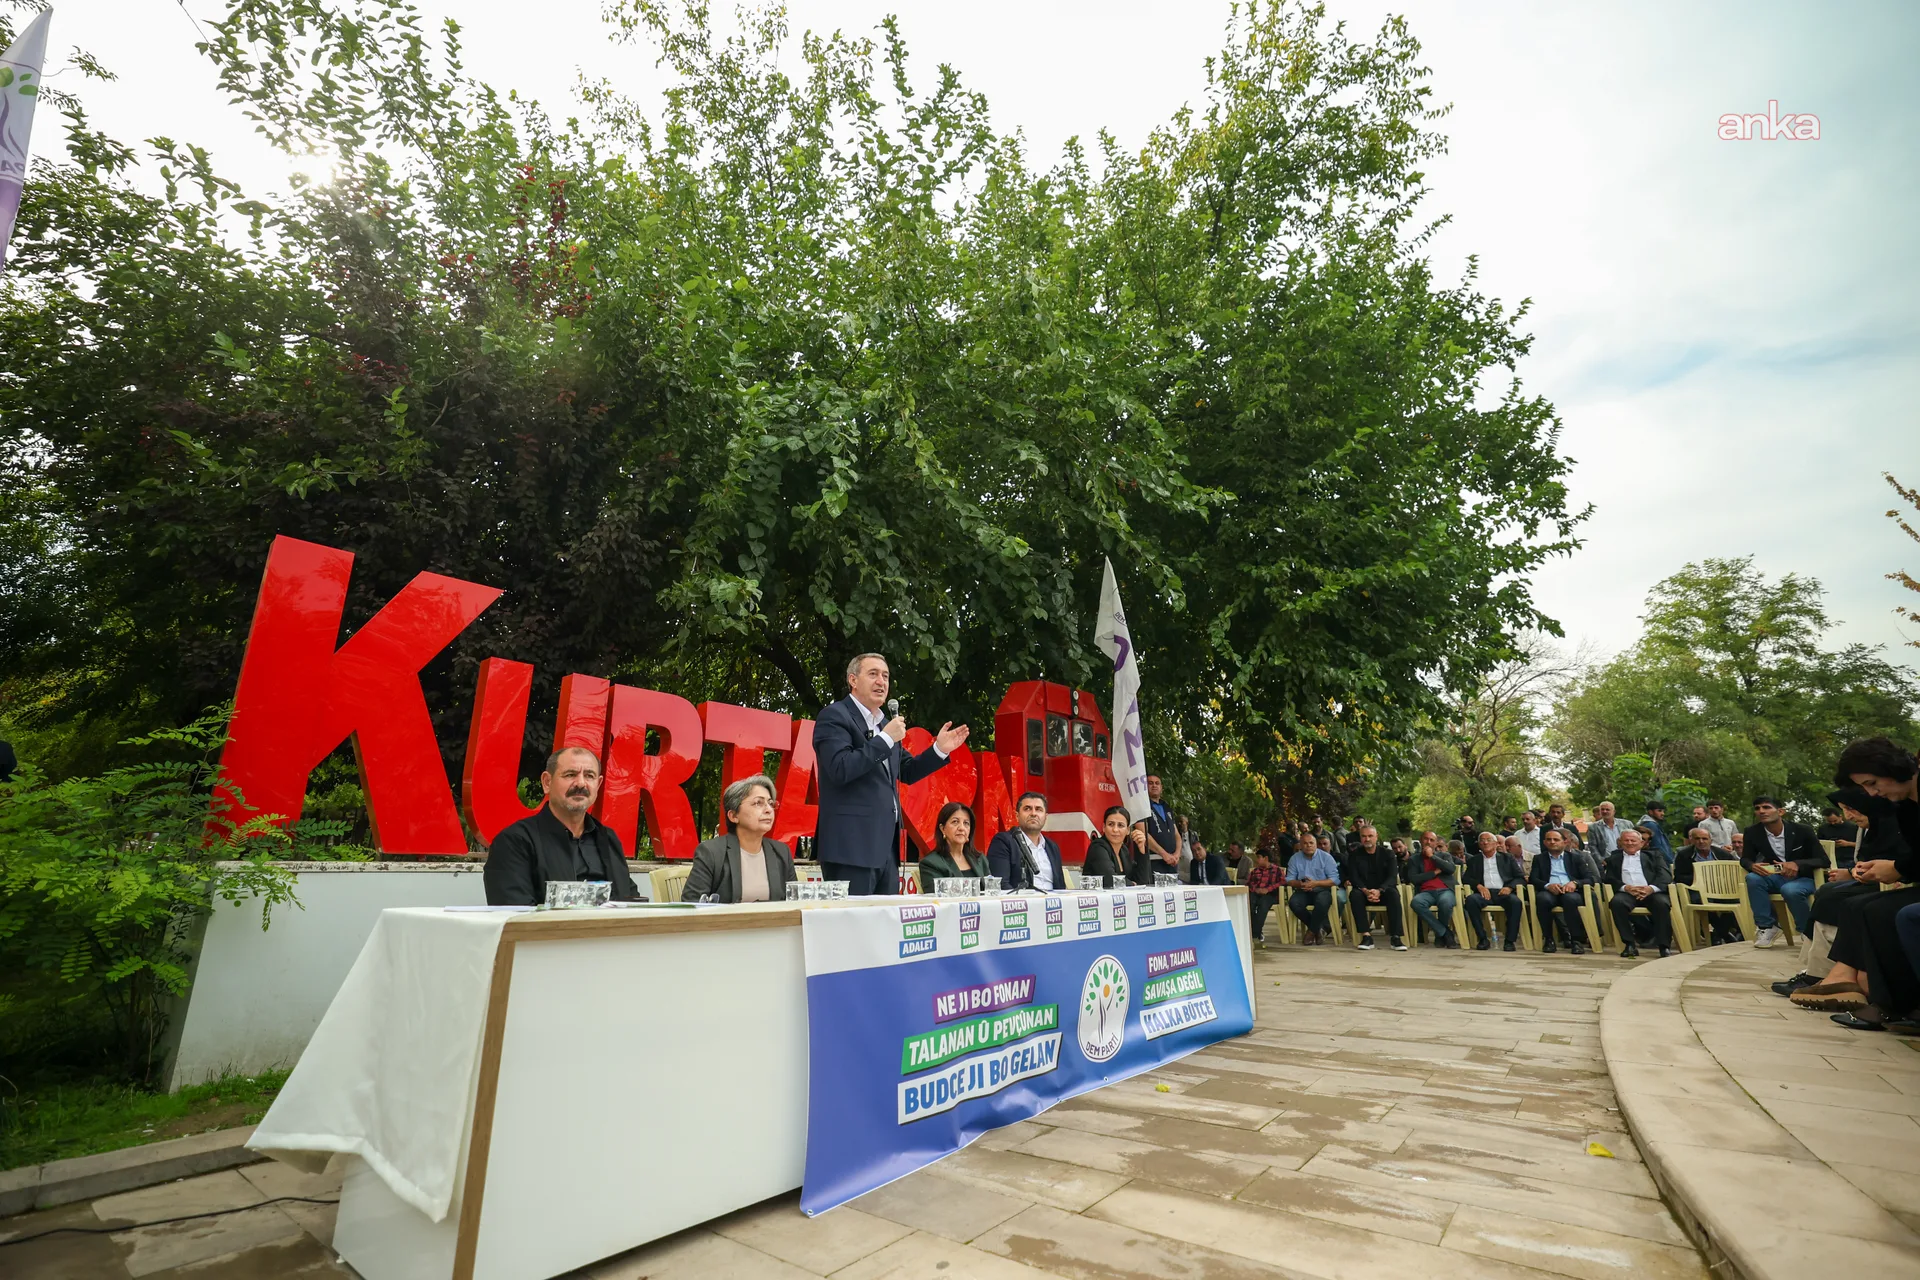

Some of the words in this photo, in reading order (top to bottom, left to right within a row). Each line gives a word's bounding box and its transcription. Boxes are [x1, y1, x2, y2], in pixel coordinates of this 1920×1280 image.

[901, 906, 934, 920] EKMEK
[961, 903, 978, 914] NAN
[1003, 901, 1027, 912] EKMEK
[962, 916, 978, 930] AŞTİ
[1005, 914, 1025, 926] BARIŞ
[905, 922, 931, 936] BARIŞ
[1048, 925, 1061, 937] DAD
[1079, 922, 1100, 933] ADALET
[962, 934, 977, 946] DAD
[1001, 929, 1029, 942] ADALET
[902, 939, 934, 955] ADALET
[1148, 954, 1170, 973] FONA,
[1170, 949, 1195, 967] TALANA
[1144, 978, 1177, 1001] SAVAŞA
[1176, 970, 1203, 993] DEĞİL
[936, 993, 957, 1018] NE
[959, 990, 969, 1013] JI
[971, 987, 992, 1009] BO
[993, 979, 1031, 1006] FONAN
[1143, 1007, 1184, 1034] HALKA
[1181, 1000, 1213, 1021] BÜTÇE
[909, 1024, 975, 1066] TALANAN
[978, 1020, 990, 1043] Û
[993, 1008, 1053, 1041] PEVÇÛNAN
[1085, 1041, 1100, 1056] DEM
[1101, 1032, 1119, 1056] PARTİ
[967, 1062, 985, 1091] JI
[989, 1055, 1009, 1087] BO
[1010, 1039, 1057, 1077] GELAN
